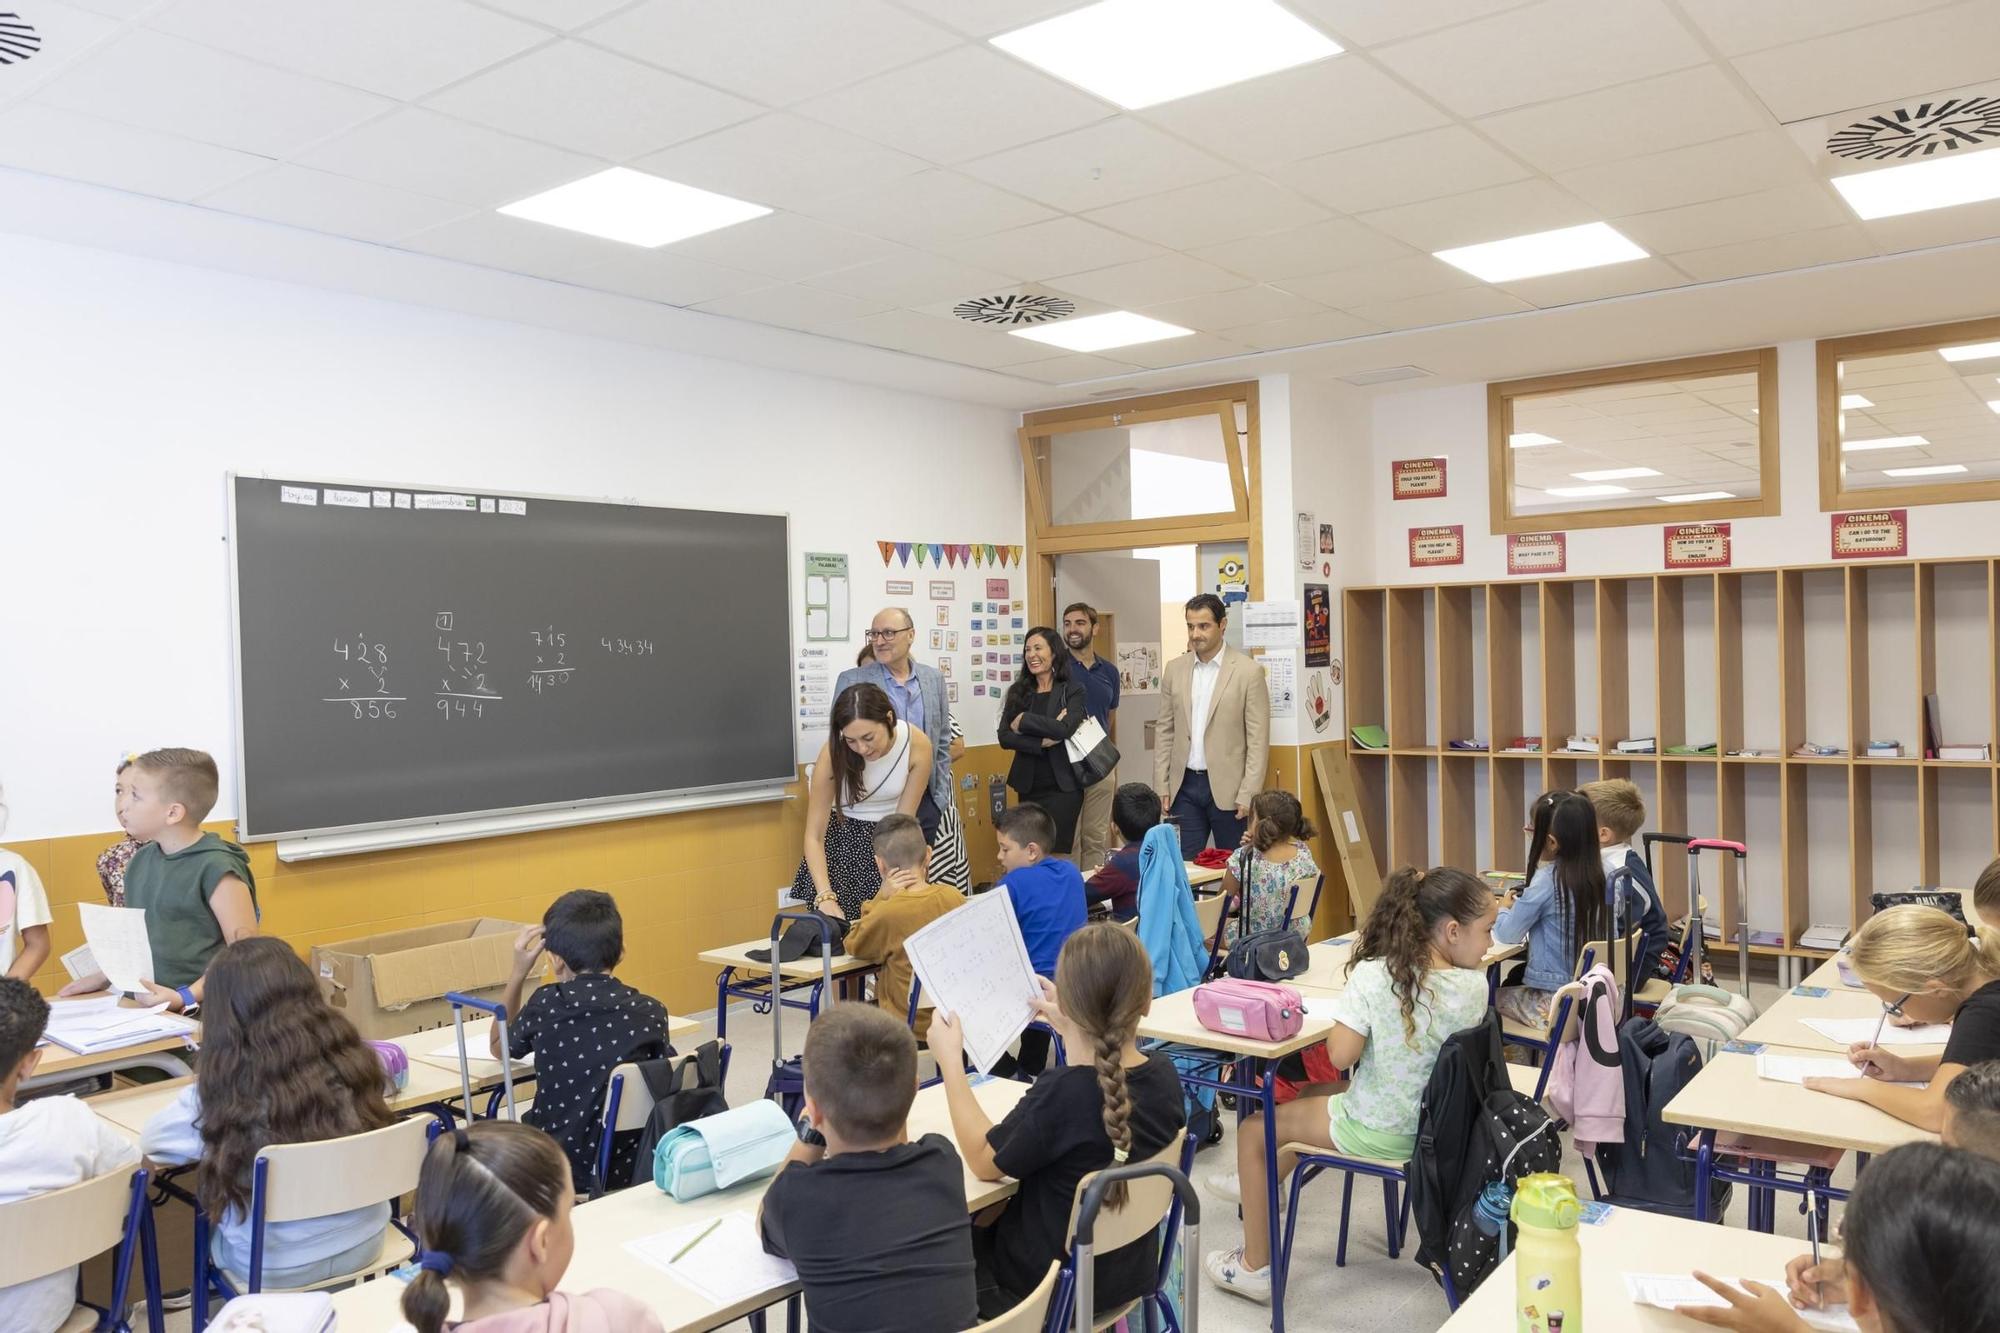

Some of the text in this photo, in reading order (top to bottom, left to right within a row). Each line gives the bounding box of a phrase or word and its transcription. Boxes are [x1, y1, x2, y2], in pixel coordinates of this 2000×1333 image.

[1404, 461, 1434, 469] CINEMA
[1848, 513, 1889, 522] CINEMA
[1421, 528, 1451, 536] CINEMA
[1679, 527, 1715, 535] CINEMA
[1284, 692, 1291, 701] 2
[1915, 895, 1938, 906] ONLY
